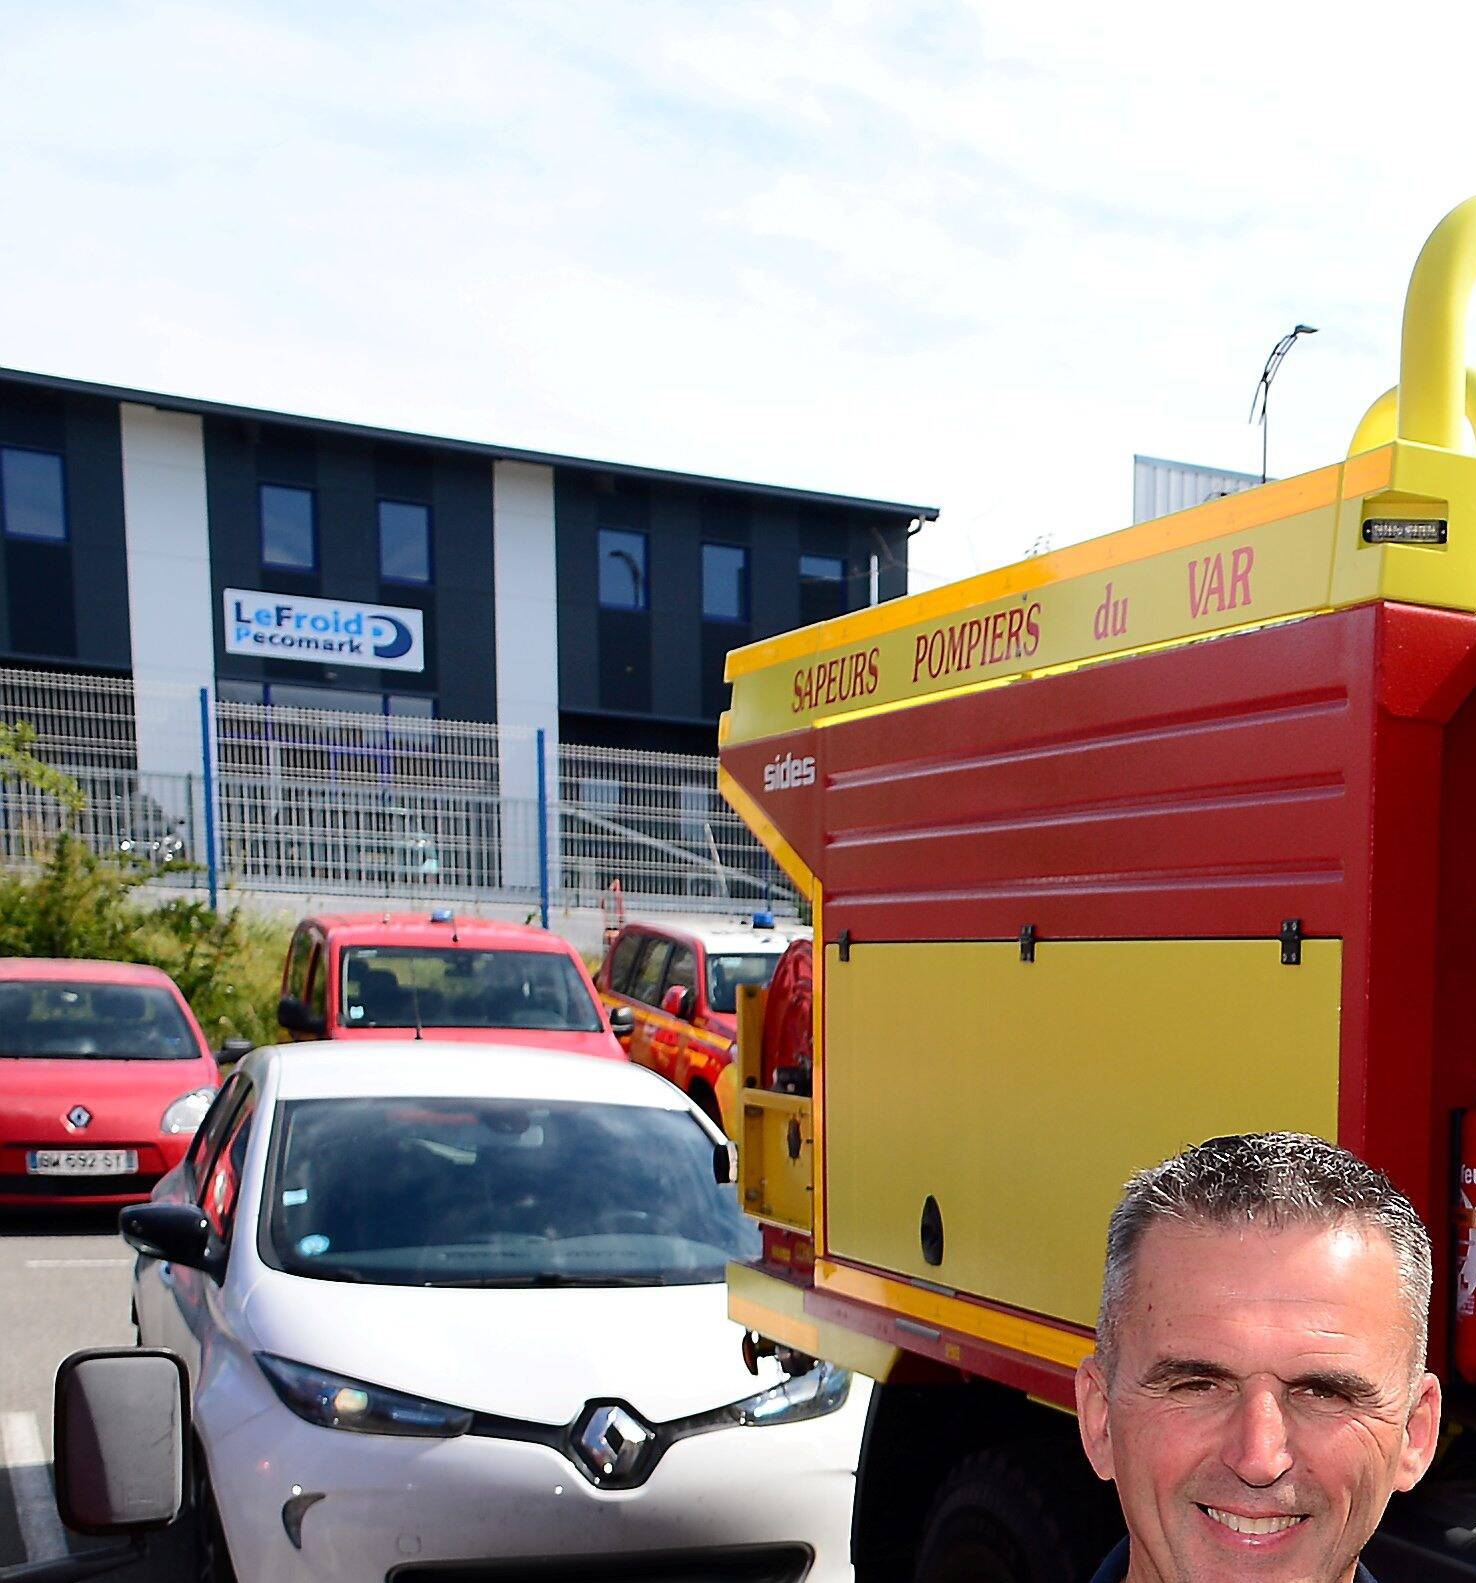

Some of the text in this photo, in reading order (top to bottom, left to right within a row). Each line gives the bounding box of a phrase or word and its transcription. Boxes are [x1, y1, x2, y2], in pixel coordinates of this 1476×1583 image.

[234, 600, 364, 636] LeFroid
[791, 545, 1255, 714] SAPEURS POMPIERS du VAR
[234, 624, 363, 654] Pecomark
[764, 753, 816, 792] sides
